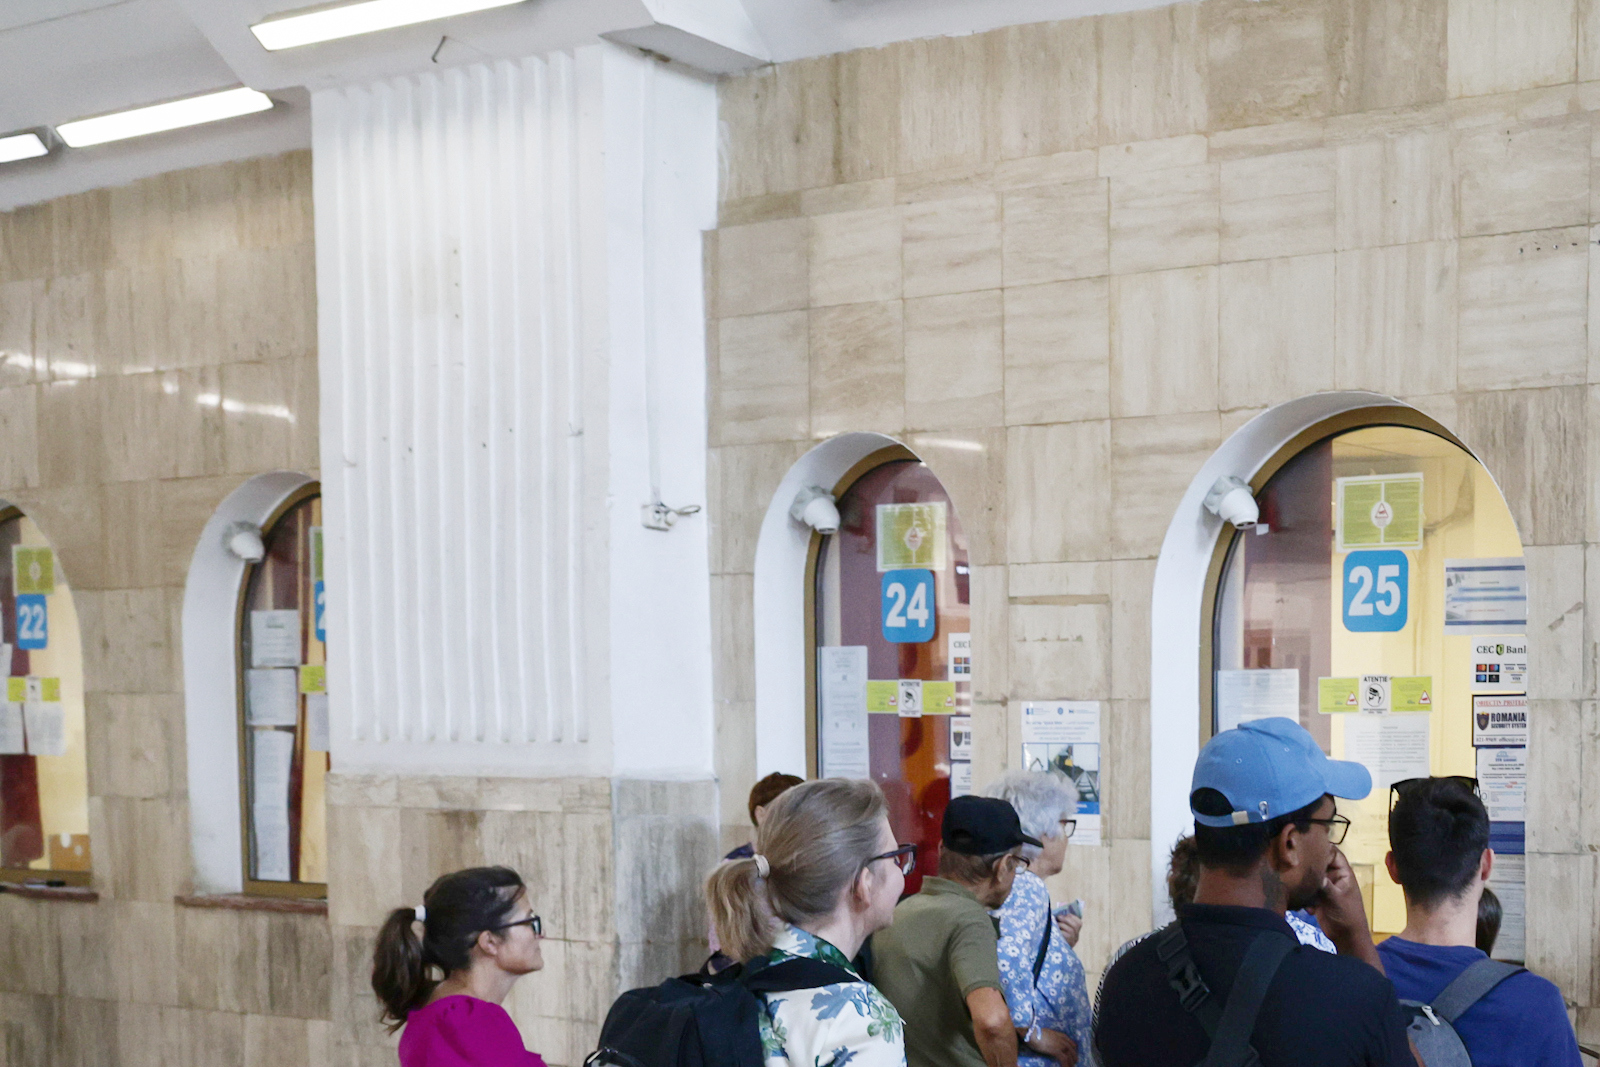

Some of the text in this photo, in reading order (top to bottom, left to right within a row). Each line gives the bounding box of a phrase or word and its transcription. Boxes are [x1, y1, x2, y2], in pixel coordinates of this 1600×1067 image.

[885, 582, 929, 628] 24
[1348, 564, 1401, 616] 25
[18, 604, 46, 640] 22
[317, 590, 327, 630] 2
[1476, 645, 1495, 654] CEC
[1490, 712, 1527, 722] ROMANIA
